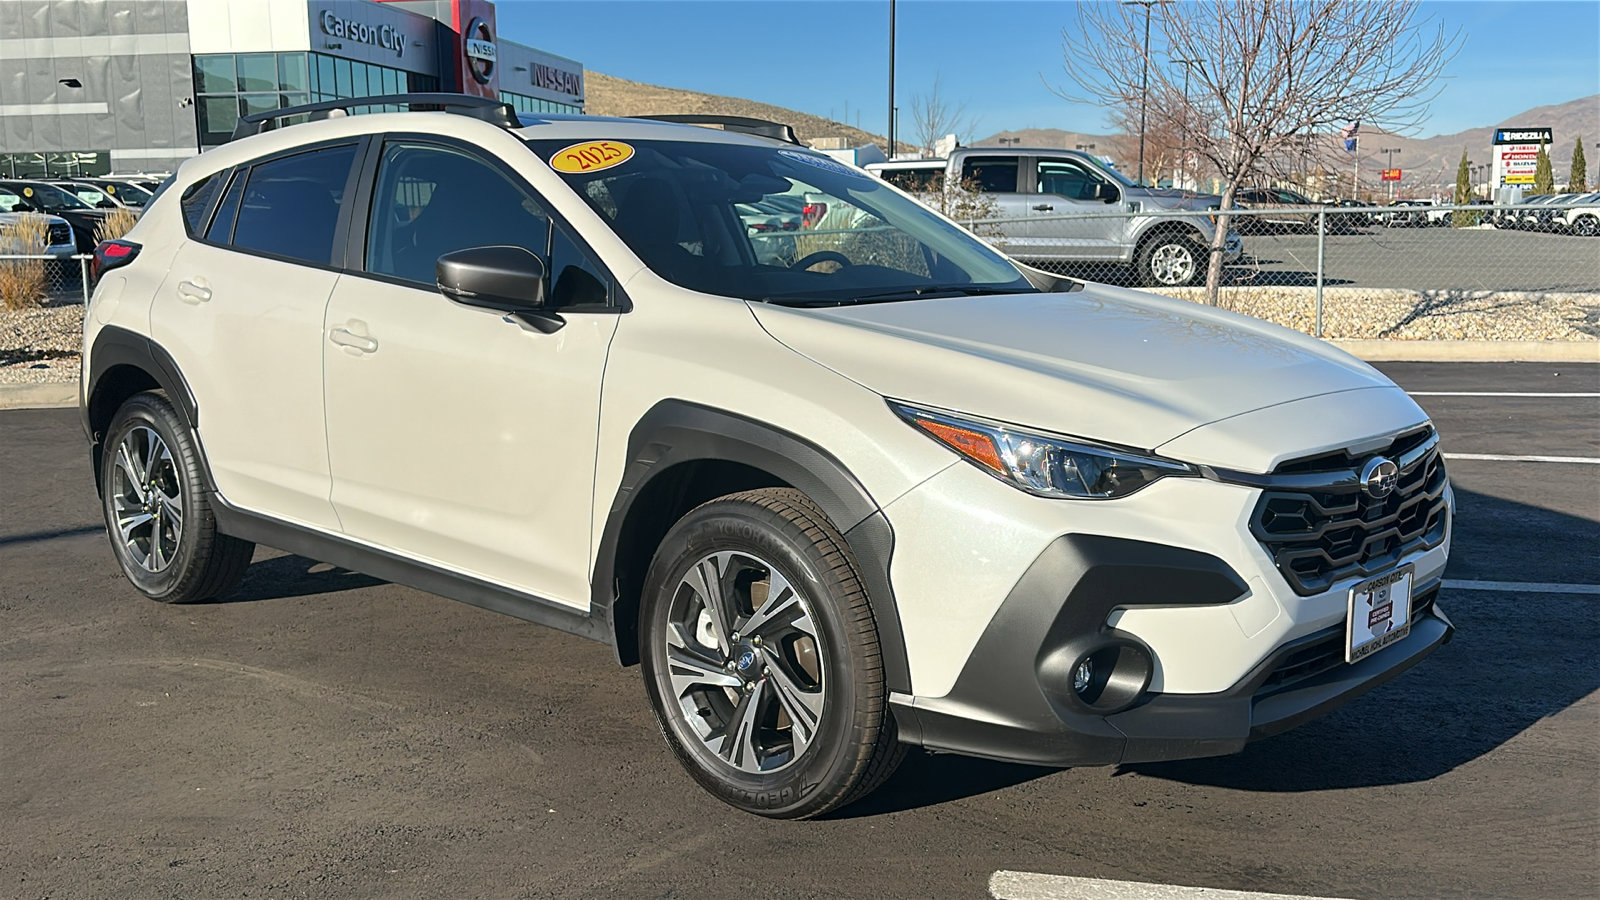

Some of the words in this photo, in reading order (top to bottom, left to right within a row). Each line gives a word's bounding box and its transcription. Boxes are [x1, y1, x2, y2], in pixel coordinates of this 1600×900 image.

[321, 9, 377, 45] Carson
[378, 24, 407, 57] City
[473, 42, 496, 57] NISSA
[531, 63, 581, 96] NISSAN
[1510, 131, 1551, 140] RIDEZILLA
[566, 142, 622, 170] 2025
[1368, 575, 1389, 591] CARSON
[1390, 571, 1402, 582] CITY
[1352, 645, 1370, 660] MICHAEL
[1371, 641, 1381, 652] HOHL
[1383, 626, 1409, 645] AUTOMOTIVE
